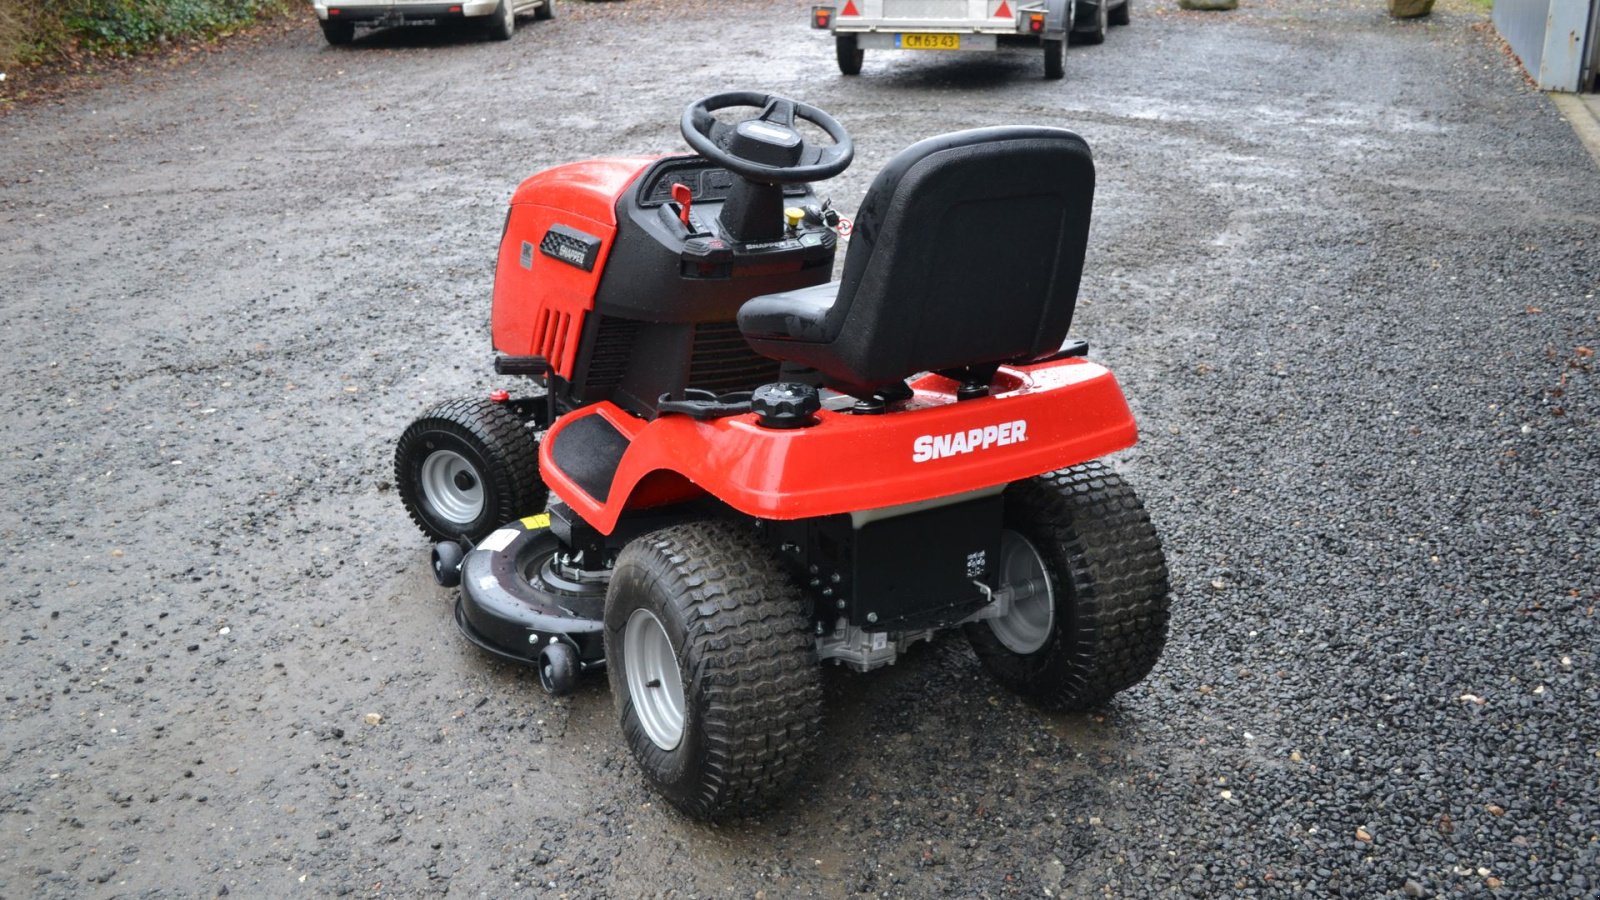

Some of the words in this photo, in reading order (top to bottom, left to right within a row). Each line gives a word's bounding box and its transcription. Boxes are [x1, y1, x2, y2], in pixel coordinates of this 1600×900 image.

[906, 35, 922, 47] CM
[924, 35, 938, 47] 63
[941, 36, 955, 47] 43
[912, 419, 1027, 463] SNAPPER
